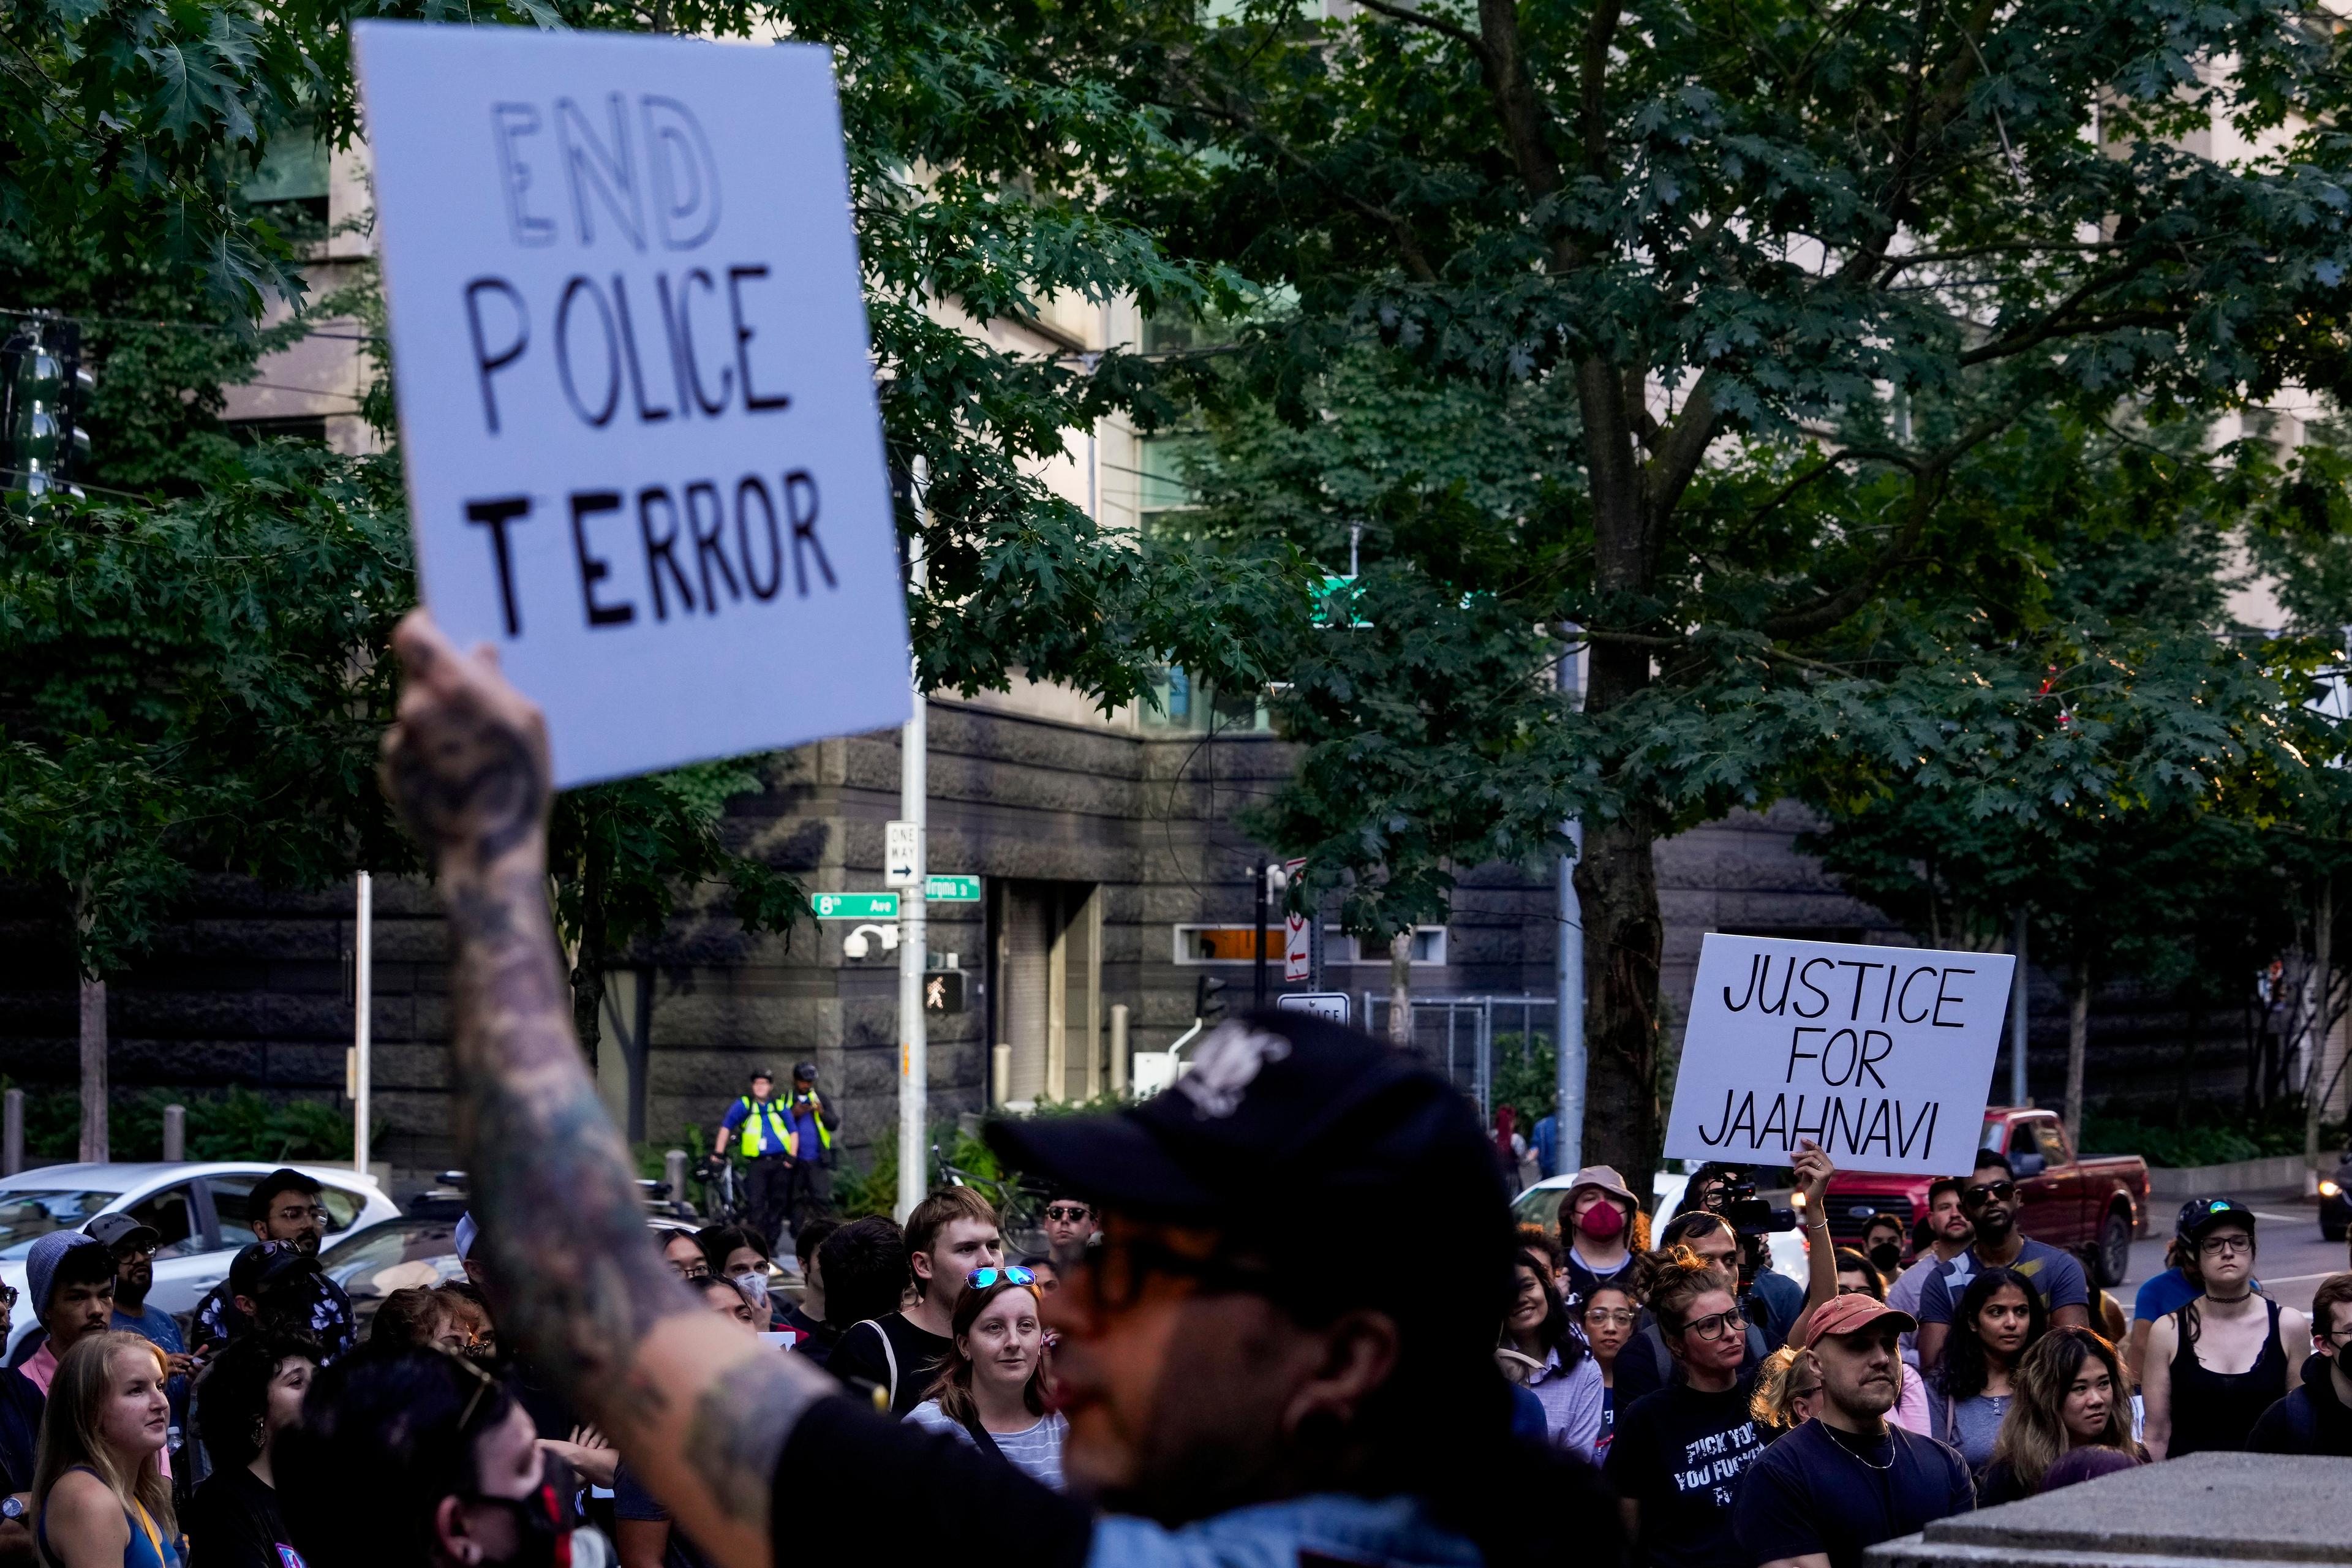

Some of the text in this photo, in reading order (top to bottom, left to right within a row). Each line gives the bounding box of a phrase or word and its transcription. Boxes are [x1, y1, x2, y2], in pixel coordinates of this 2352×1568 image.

[491, 91, 723, 254] END
[464, 262, 793, 436] POLICE
[465, 467, 839, 638] TERROR
[892, 827, 914, 842] ONE
[892, 846, 916, 859] WAY
[870, 899, 892, 912] Ave
[1723, 954, 1976, 1028] JUSTICE
[1786, 1027, 1893, 1089] FOR
[1698, 1089, 1939, 1160] JAAHNAVI
[1674, 1465, 1711, 1491] YOU
[1686, 1433, 1727, 1464] FUCK
